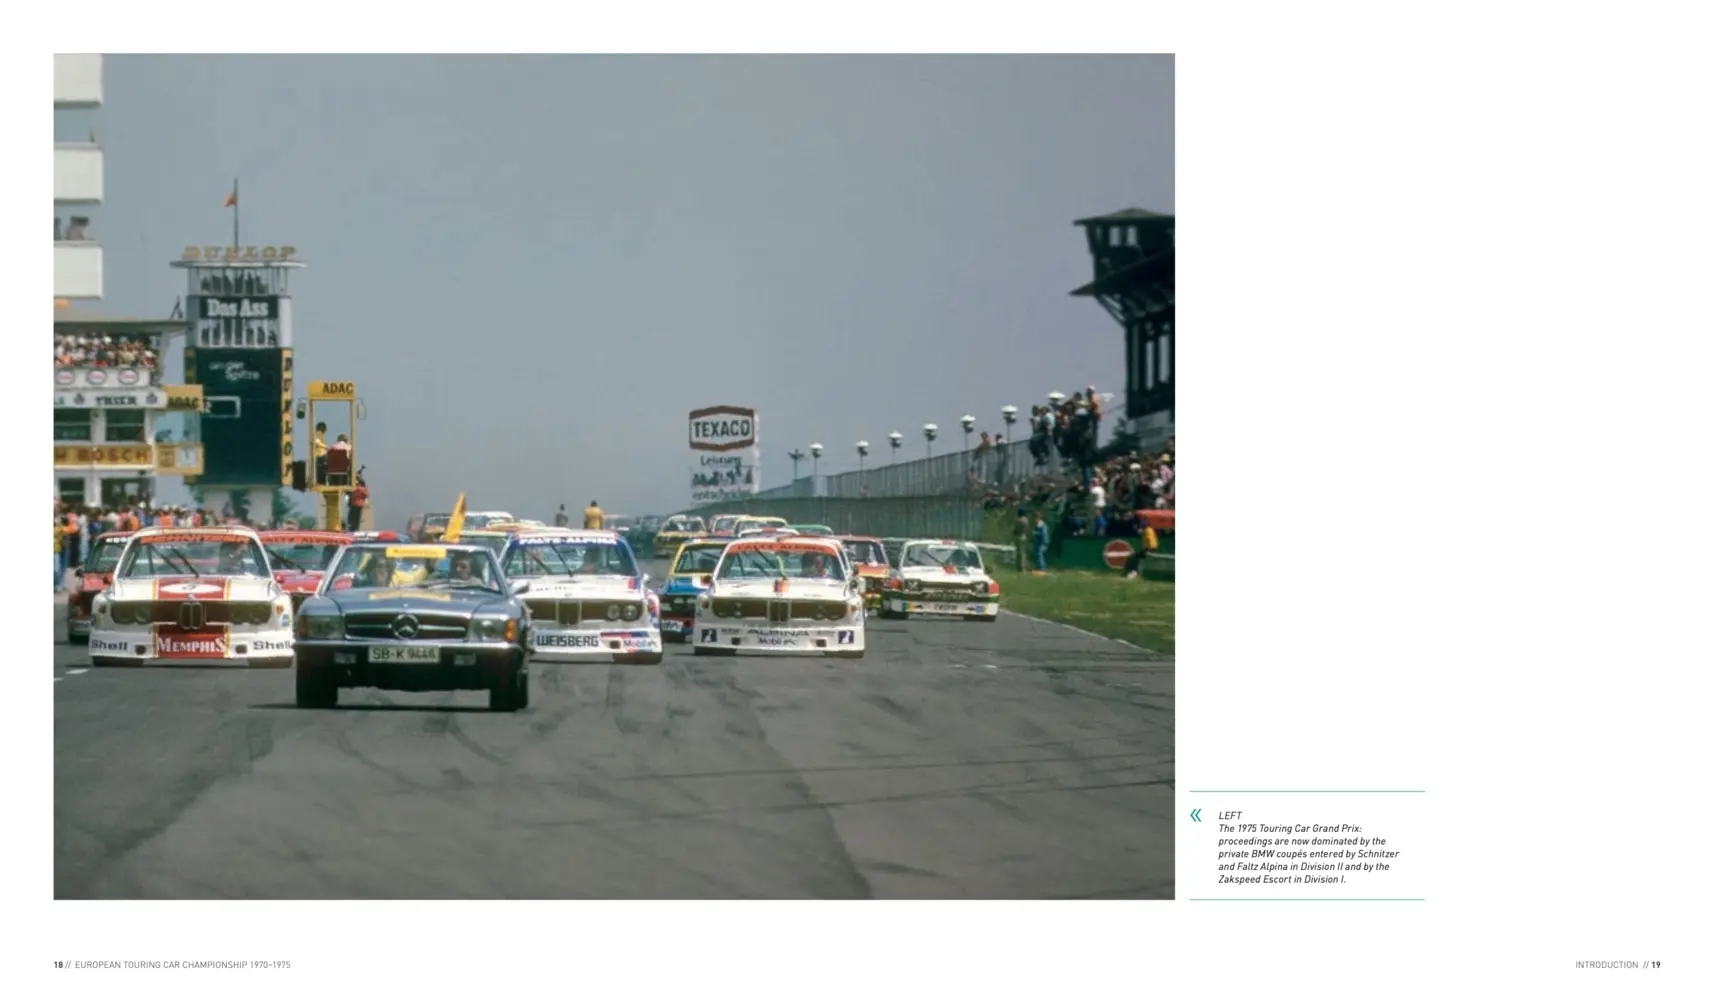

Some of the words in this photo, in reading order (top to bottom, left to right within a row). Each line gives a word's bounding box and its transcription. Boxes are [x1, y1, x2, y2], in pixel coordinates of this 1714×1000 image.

[182, 245, 297, 260] DUNLOP
[207, 298, 238, 317] Das
[240, 298, 269, 317] Ass
[322, 382, 354, 394] ADAC
[693, 419, 750, 438] TEXACO
[77, 448, 149, 462] BOSCH
[91, 639, 128, 651] Shell
[156, 637, 227, 653] MEMPHIS
[253, 640, 292, 650] Shell
[536, 635, 599, 647] WEISBERG
